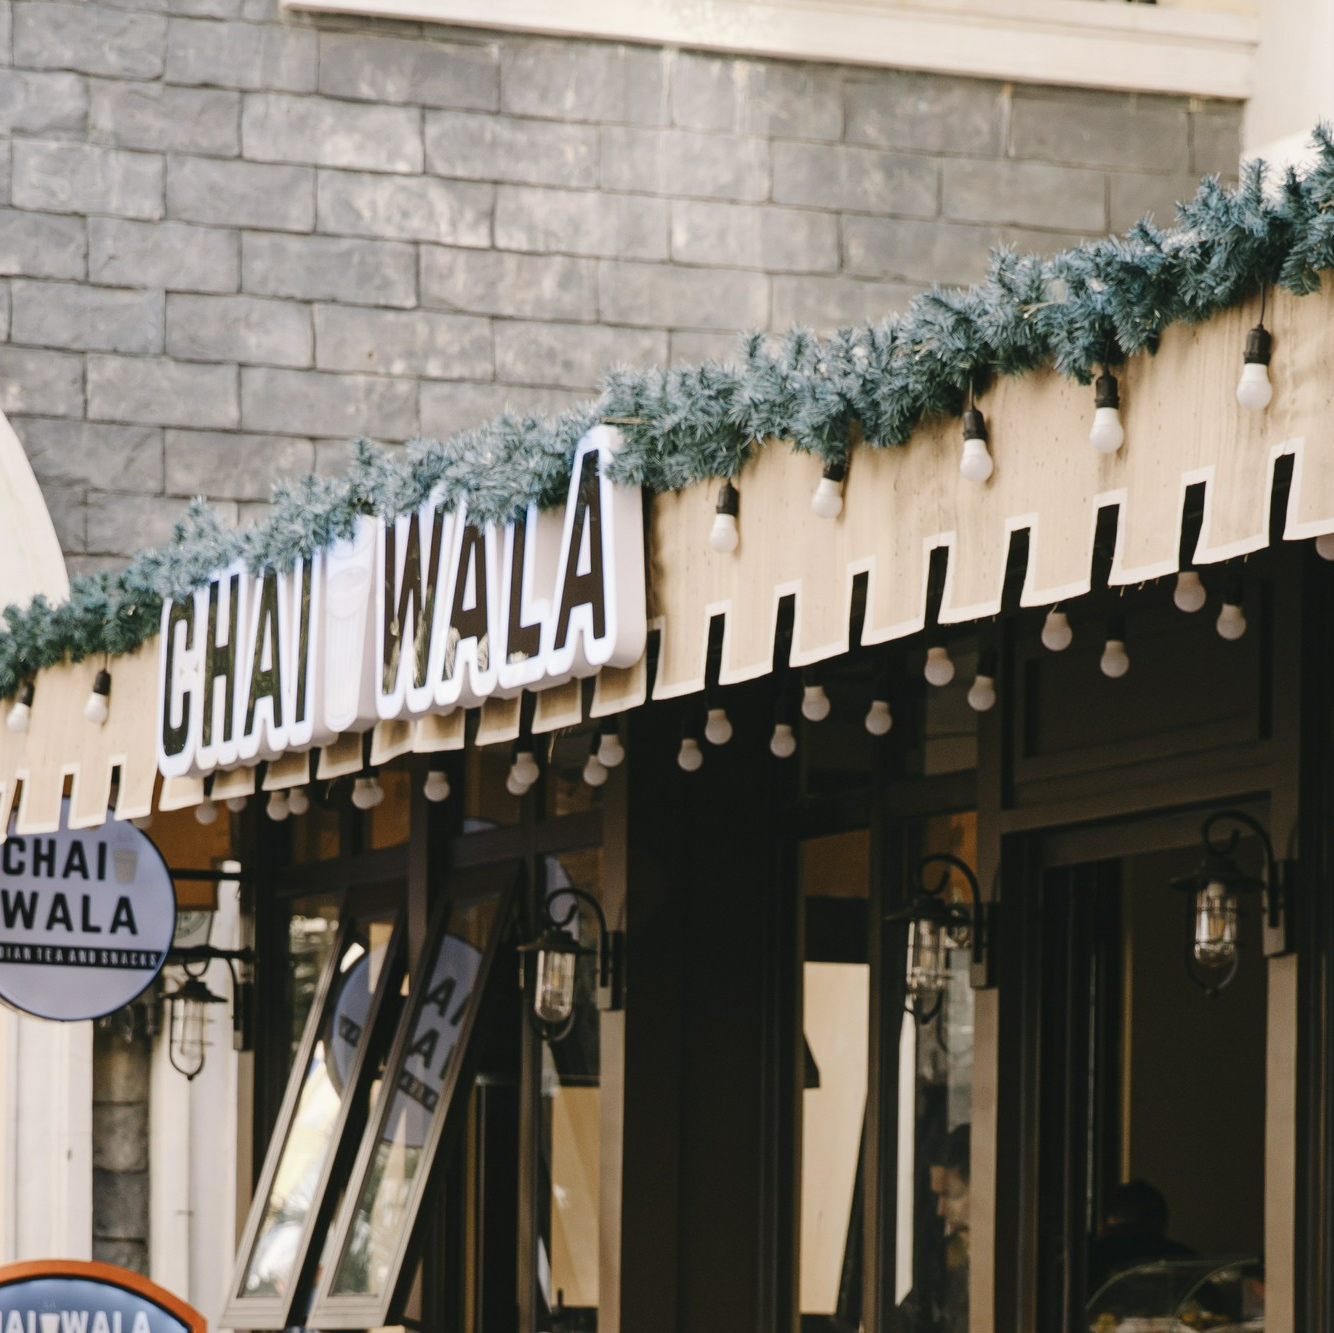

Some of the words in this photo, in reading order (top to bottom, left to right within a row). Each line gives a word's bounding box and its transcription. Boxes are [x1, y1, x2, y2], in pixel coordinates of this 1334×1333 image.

[162, 556, 313, 758] CHAI
[382, 449, 607, 695] WALA
[1, 837, 108, 881] CHAI
[0, 889, 138, 935] WALA
[37, 946, 64, 962] TEA
[69, 948, 96, 964] AND
[101, 950, 157, 967] SNACKS
